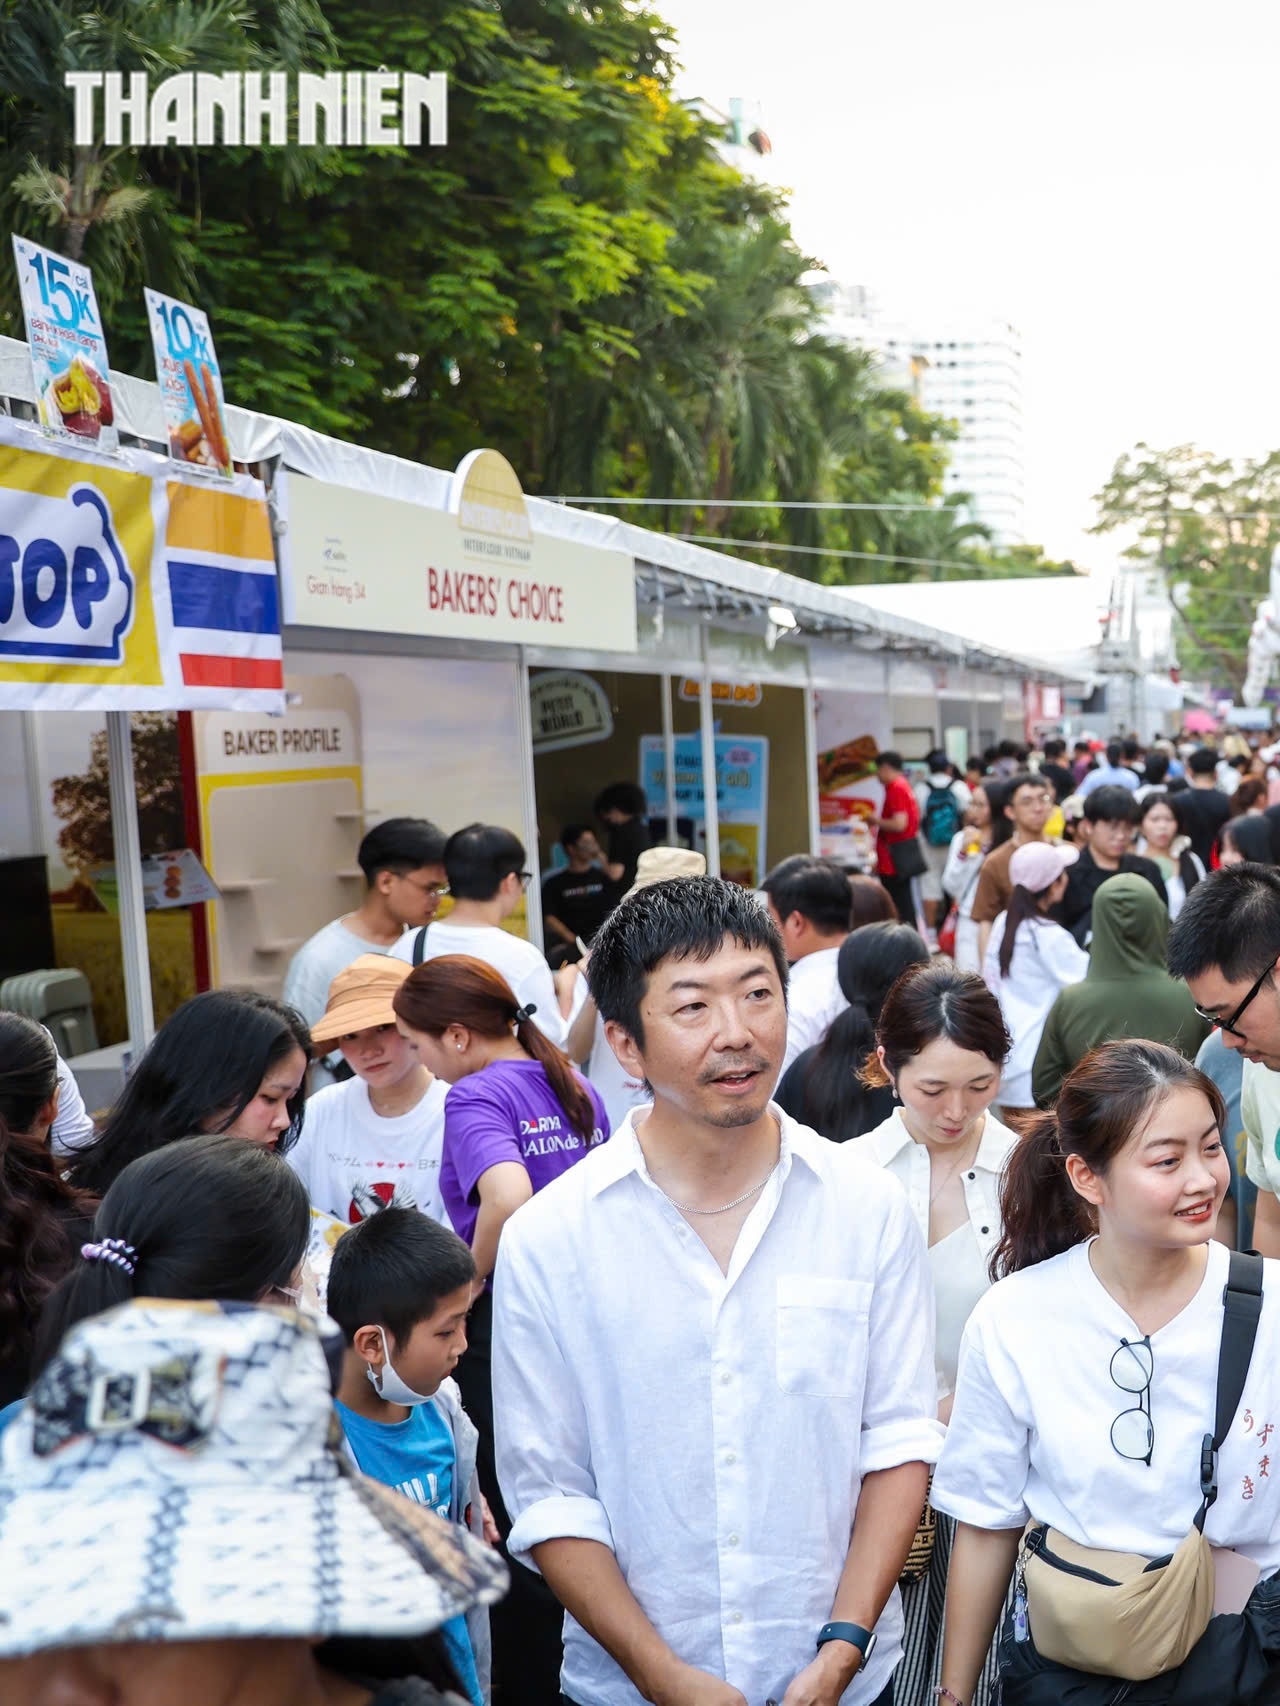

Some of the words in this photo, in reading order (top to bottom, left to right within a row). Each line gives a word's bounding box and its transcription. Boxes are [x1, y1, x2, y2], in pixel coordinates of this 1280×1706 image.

[507, 579, 565, 623] CHOICE
[224, 731, 277, 756] BAKER
[283, 728, 342, 752] PROFILE
